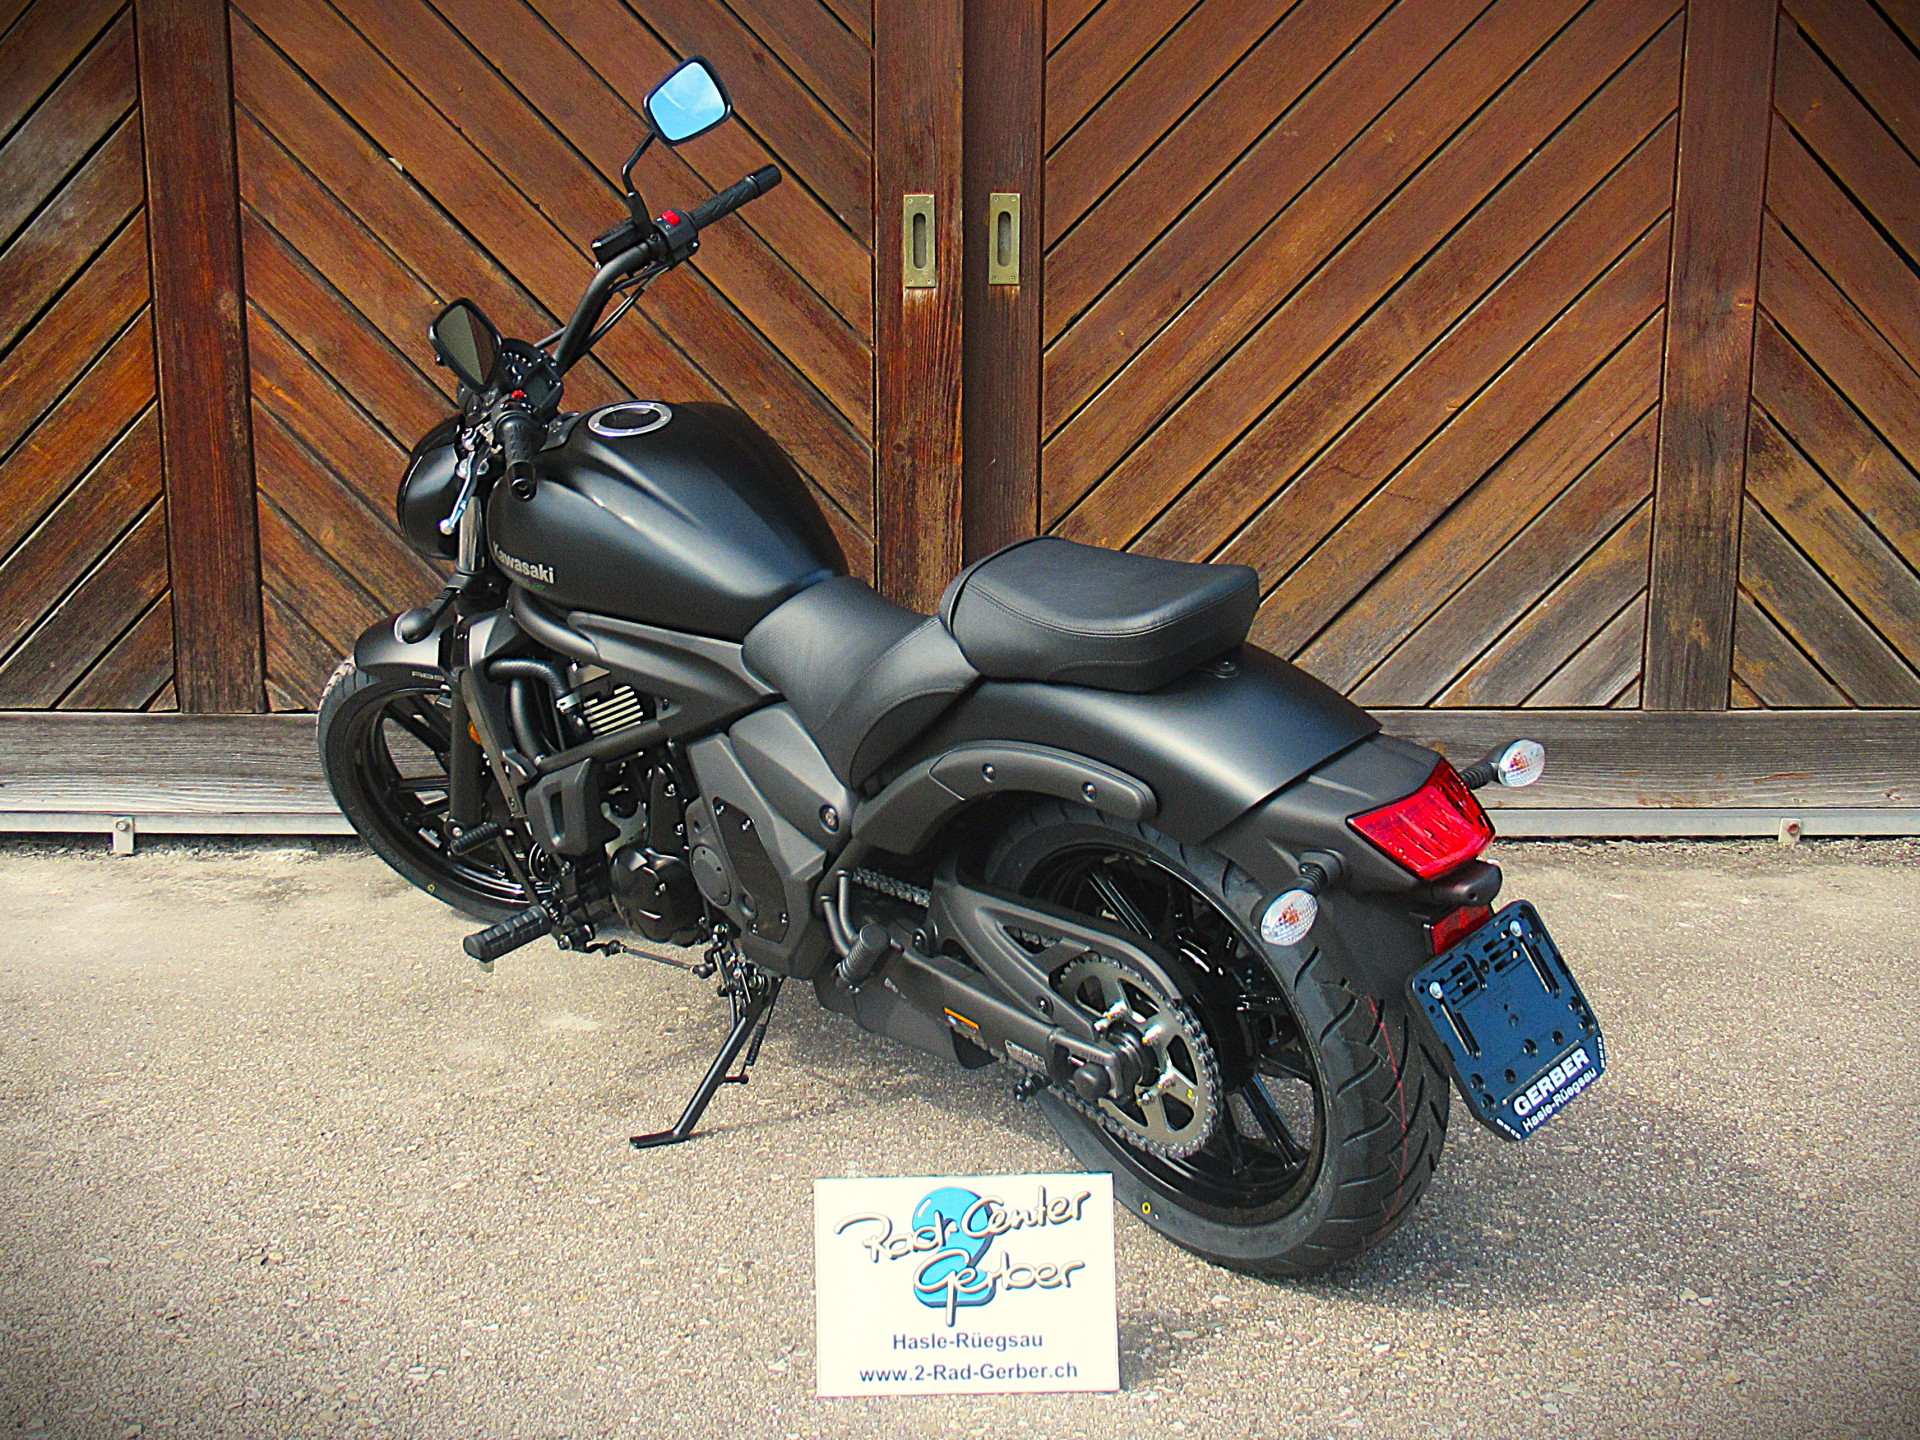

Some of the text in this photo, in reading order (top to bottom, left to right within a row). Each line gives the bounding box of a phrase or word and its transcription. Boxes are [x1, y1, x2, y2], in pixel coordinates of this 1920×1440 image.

[493, 540, 554, 584] Kawasaki
[1513, 1047, 1591, 1116] GERBER
[912, 1248, 1086, 1328] Gerber
[893, 1332, 1043, 1351] Hasle-Rüegsau
[859, 1362, 1078, 1382] www.2-Rad-Gerber.ch
